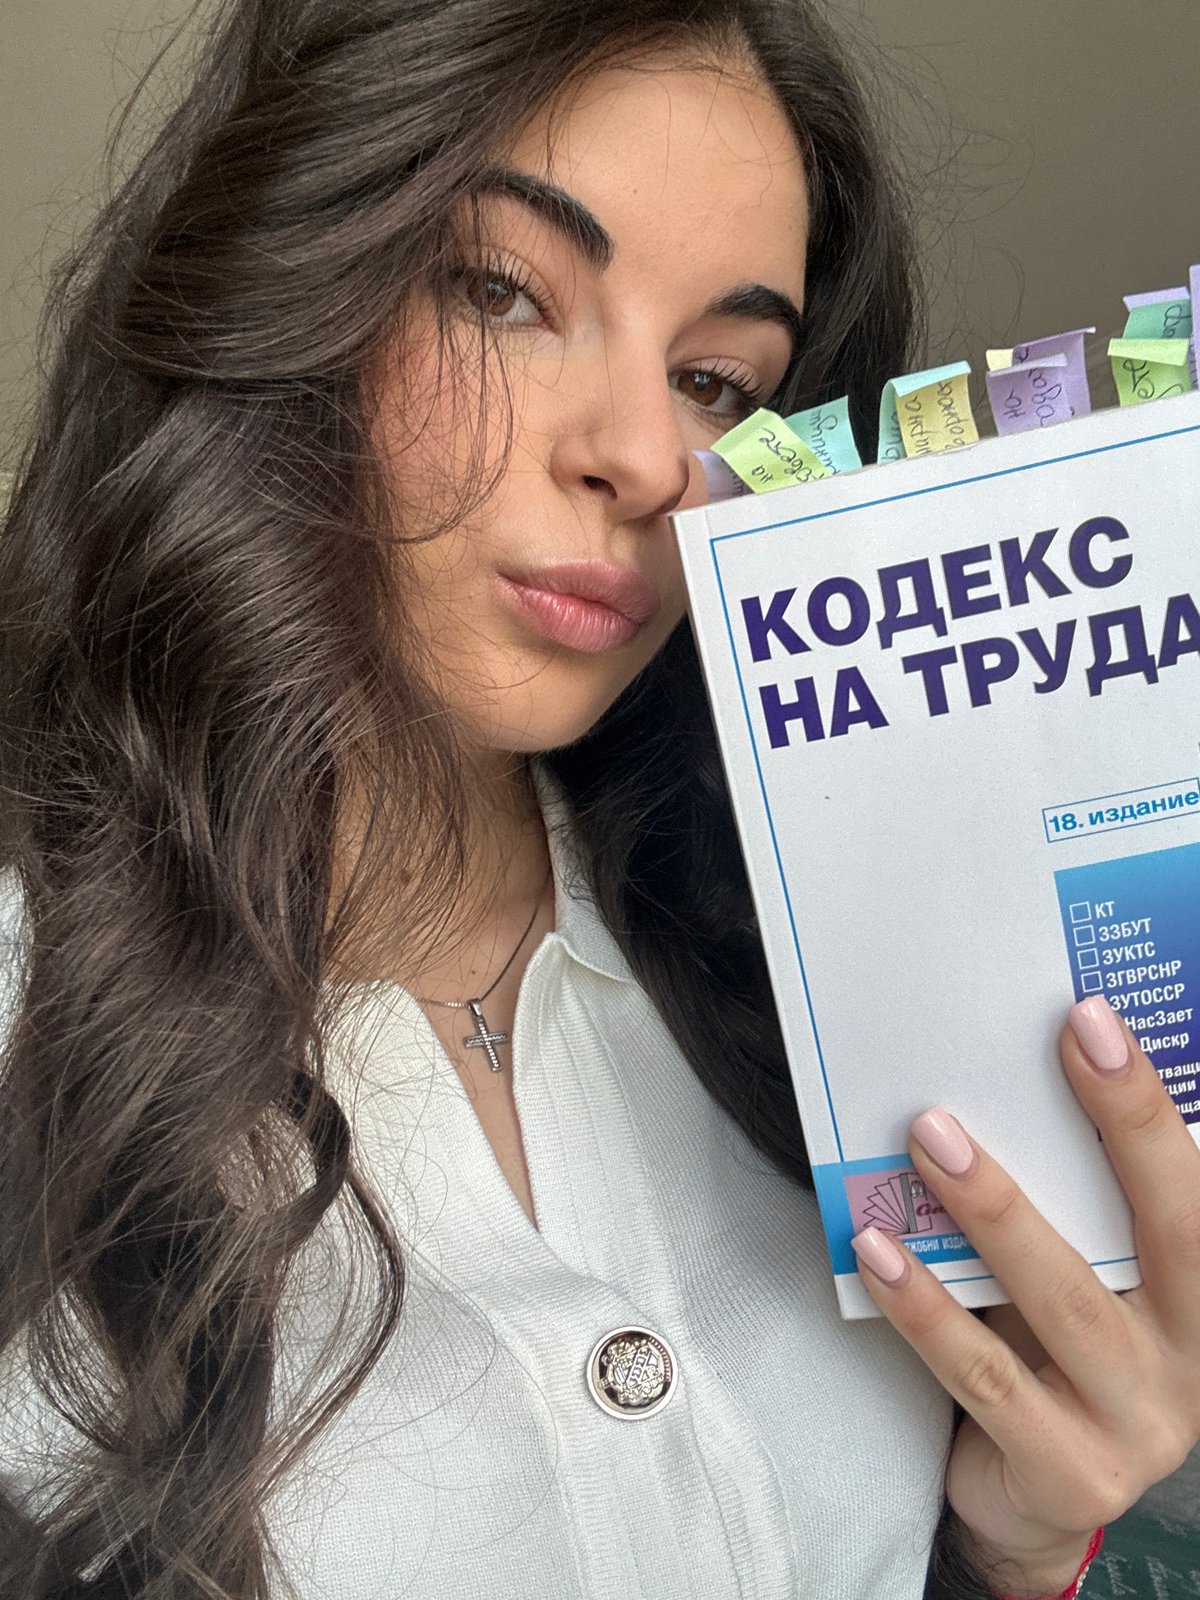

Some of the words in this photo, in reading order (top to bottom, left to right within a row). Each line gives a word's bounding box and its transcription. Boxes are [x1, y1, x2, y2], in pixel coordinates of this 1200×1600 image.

[740, 516, 1134, 663] КОДЕКС
[758, 665, 890, 749] НА
[902, 592, 1200, 717] ТРУДА
[1048, 813, 1084, 832] 18.
[1088, 791, 1199, 822] издание
[1095, 901, 1115, 918] КТ
[1098, 917, 1151, 941] ЗЗБУТ
[1102, 941, 1156, 965] ЗУКТС
[1106, 960, 1182, 988] ЗГВРСНР
[1109, 983, 1185, 1011] ЗУТОССР
[1124, 1008, 1193, 1031] НасЗает
[1140, 1032, 1190, 1054] Дискр
[1164, 1079, 1197, 1096] ции
[942, 1235, 968, 1250] ИЗДА
